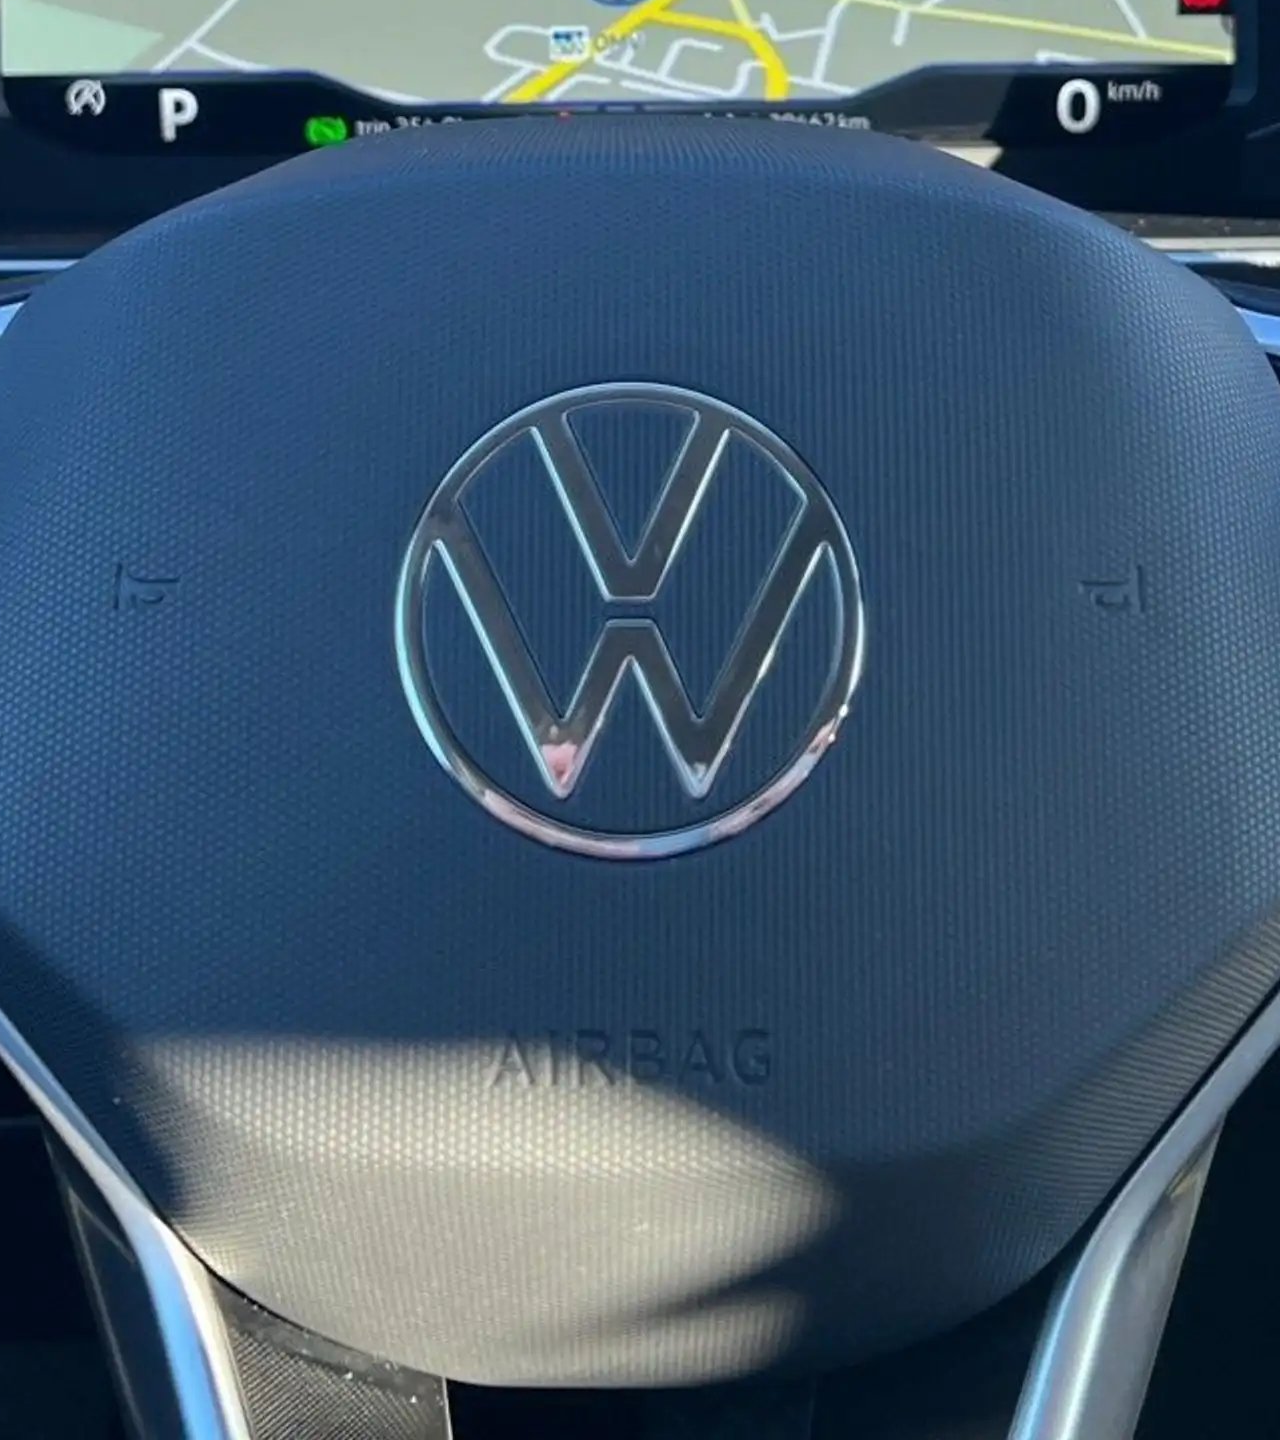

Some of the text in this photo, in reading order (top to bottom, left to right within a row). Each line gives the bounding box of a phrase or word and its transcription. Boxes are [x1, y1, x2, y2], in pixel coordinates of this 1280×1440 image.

[158, 87, 199, 143] P
[1056, 77, 1162, 135] 0 km/h
[487, 1027, 774, 1092] AIRBAG
